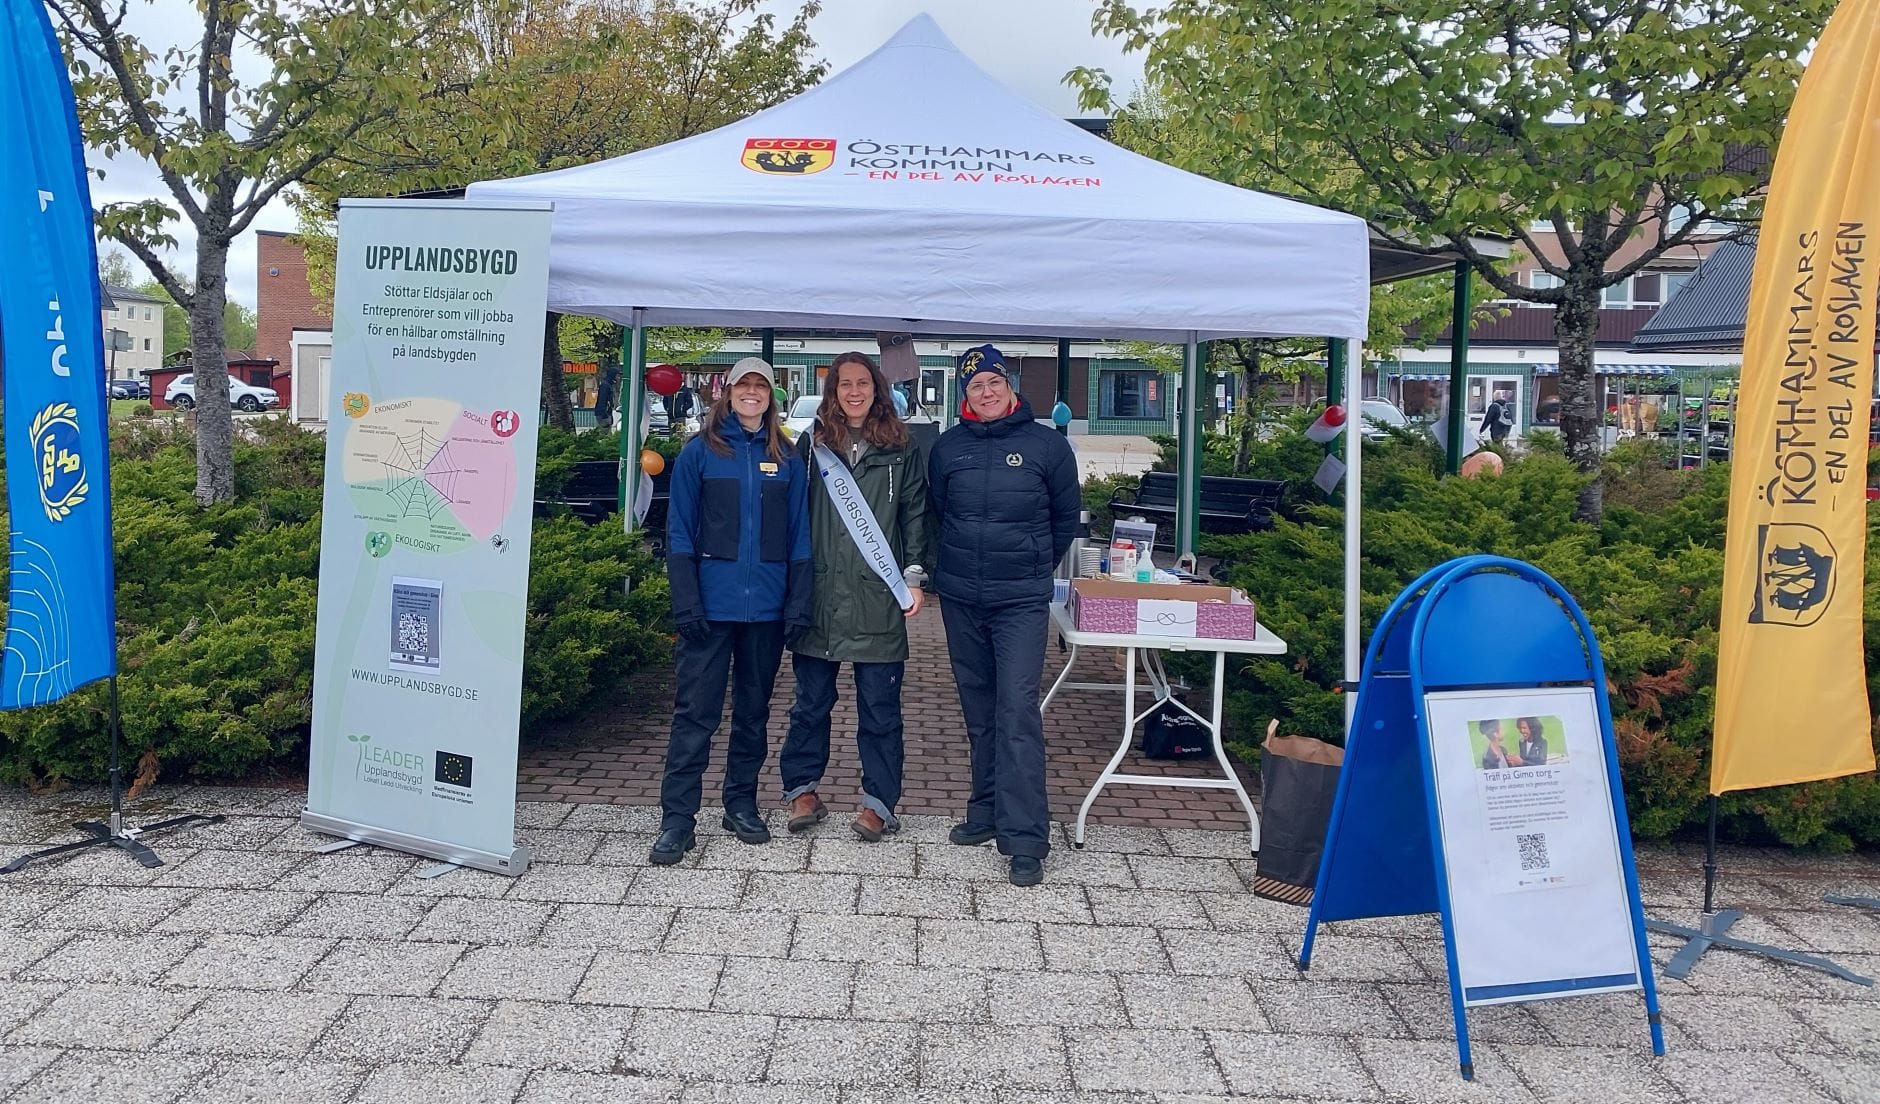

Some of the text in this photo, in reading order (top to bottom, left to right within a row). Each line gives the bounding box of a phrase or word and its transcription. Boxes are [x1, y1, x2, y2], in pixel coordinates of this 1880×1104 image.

[848, 139, 1096, 165] ÖSTHAMMARS
[849, 157, 1013, 172] KOMMUN
[868, 170, 898, 180] EN
[908, 172, 945, 181] DEL
[953, 172, 985, 183] AV
[994, 173, 1101, 187] ROSLAGEN
[365, 245, 519, 275] UPPLANDSBYGD
[384, 285, 493, 303] Stöttar Eldsjälar och
[1827, 222, 1867, 343] ROSLAGEN
[362, 303, 514, 325] Entreprenörer som vill jobba
[367, 323, 506, 346] för en hållbar omställning
[392, 344, 477, 363] på landsbygden
[1826, 353, 1859, 390] AV
[374, 400, 412, 414] EKONOMISKT
[463, 410, 489, 426] SOCIALT
[1826, 398, 1854, 440] DEL
[1825, 450, 1849, 484] EN
[833, 477, 893, 578] UPPLANDSBYGD
[395, 533, 441, 553] EKOLOGISKT
[351, 668, 479, 701] WWW.UPPLANDSBYGD.SE
[364, 745, 424, 772] LEADER
[364, 763, 423, 786] Upplandsbygd
[1502, 770, 1511, 783] på
[1513, 769, 1534, 780] Gimo
[1536, 769, 1553, 779] torg
